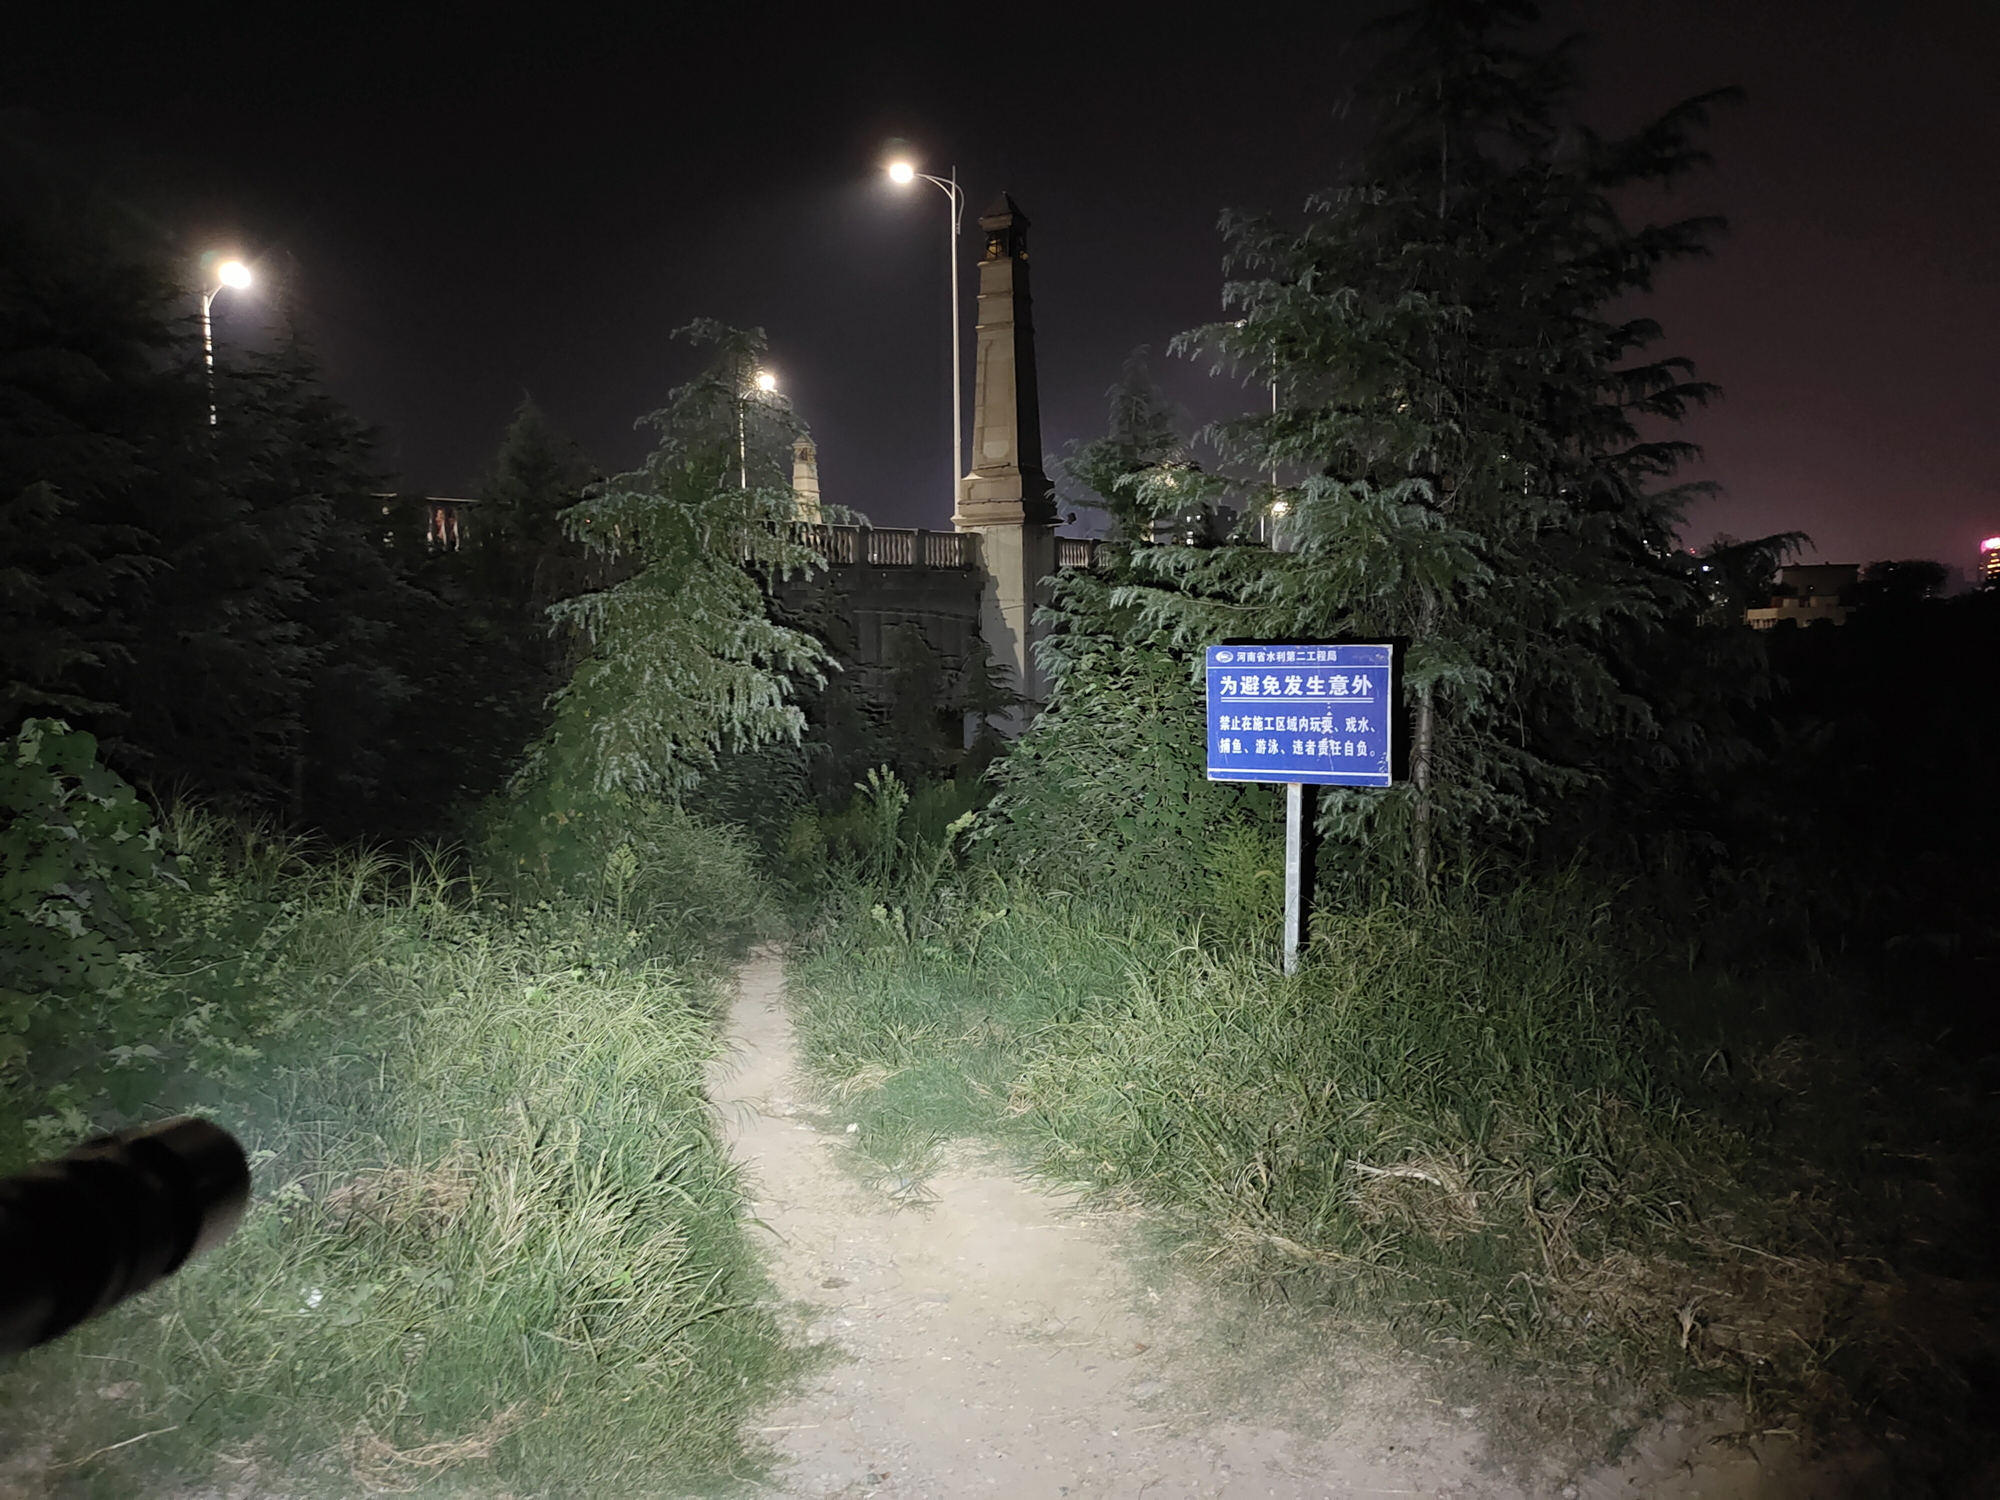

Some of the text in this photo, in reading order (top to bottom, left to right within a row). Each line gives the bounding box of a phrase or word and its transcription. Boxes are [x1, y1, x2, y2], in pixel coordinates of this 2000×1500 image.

[1236, 650, 1338, 663] 河南省水利第二工程局
[1219, 674, 1373, 696] 为避免发生意外
